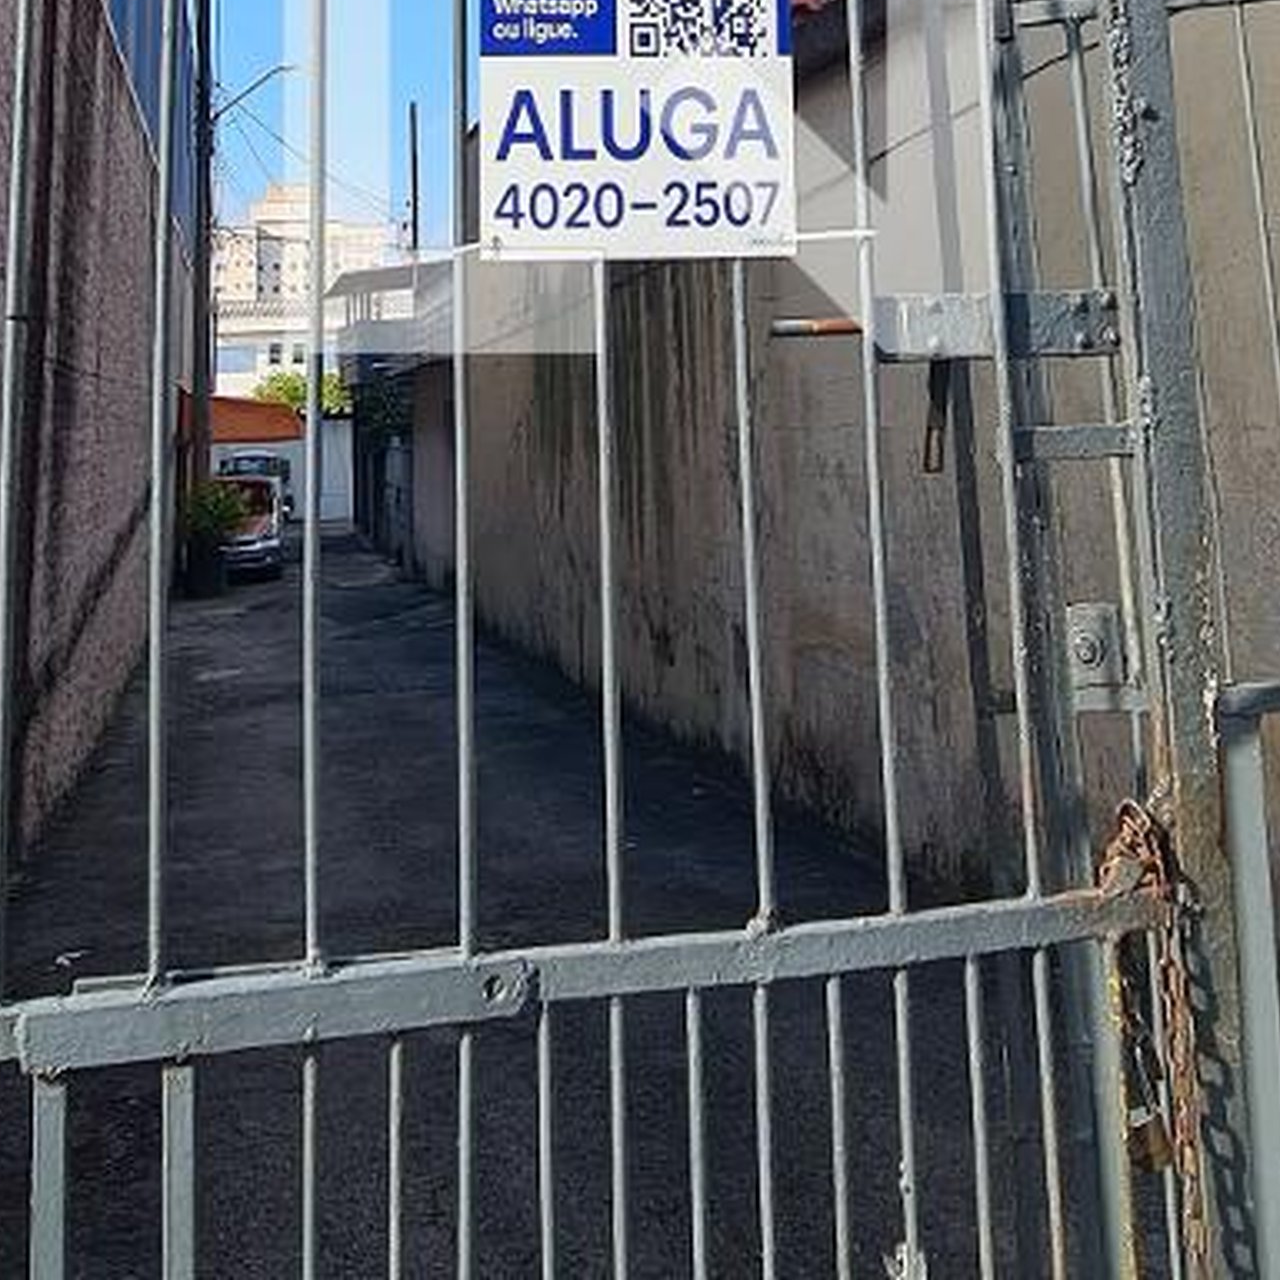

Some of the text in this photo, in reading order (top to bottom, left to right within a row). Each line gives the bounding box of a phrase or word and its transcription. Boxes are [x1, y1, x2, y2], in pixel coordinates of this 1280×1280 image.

[492, 17, 579, 44] ou ligue.
[494, 86, 780, 162] ALUGA
[493, 179, 781, 231] 4020-2507
